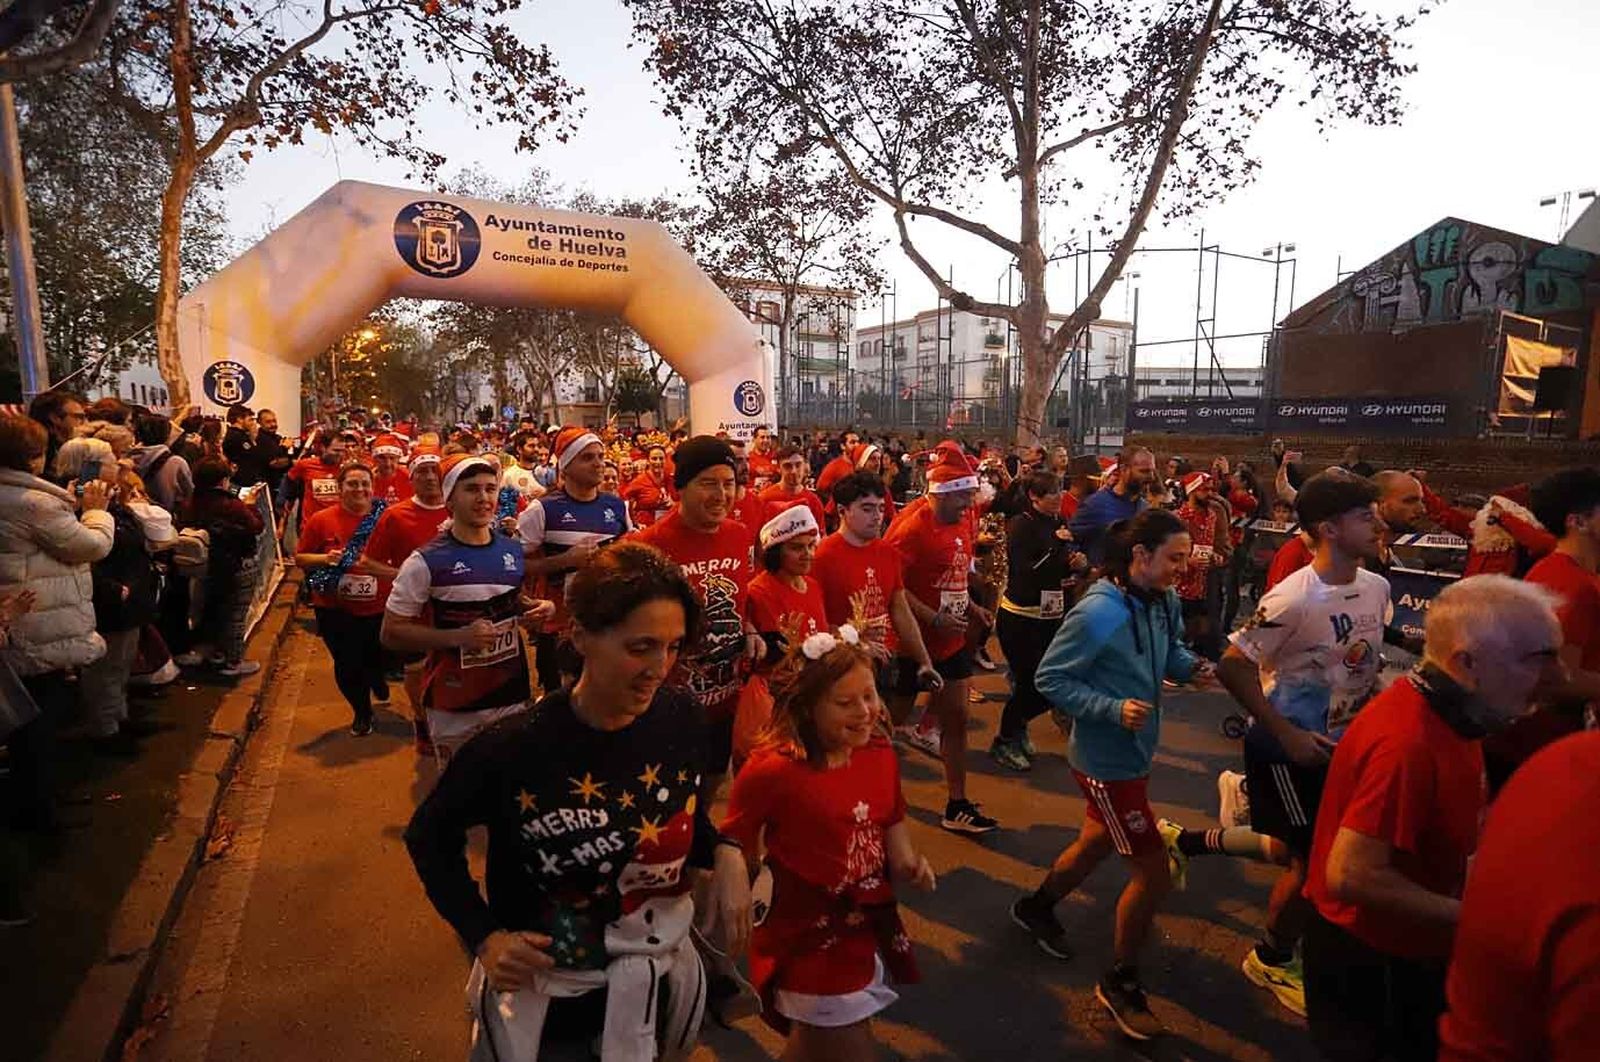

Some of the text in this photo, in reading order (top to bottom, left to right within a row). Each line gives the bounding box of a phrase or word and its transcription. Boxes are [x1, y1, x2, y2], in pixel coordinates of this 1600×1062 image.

[485, 214, 626, 241] Ayuntamiento
[528, 235, 627, 259] de Huelva
[560, 258, 575, 268] de
[578, 259, 630, 273] Deportes
[1151, 408, 1188, 417] HYUNDAI
[1213, 407, 1255, 416] HYUNDAI
[1298, 405, 1348, 416] HYUNDAI
[1386, 404, 1447, 415] HYUNDAI
[679, 557, 742, 577] MERRY
[521, 808, 609, 839] MERRY
[537, 831, 625, 875] X-MAS
